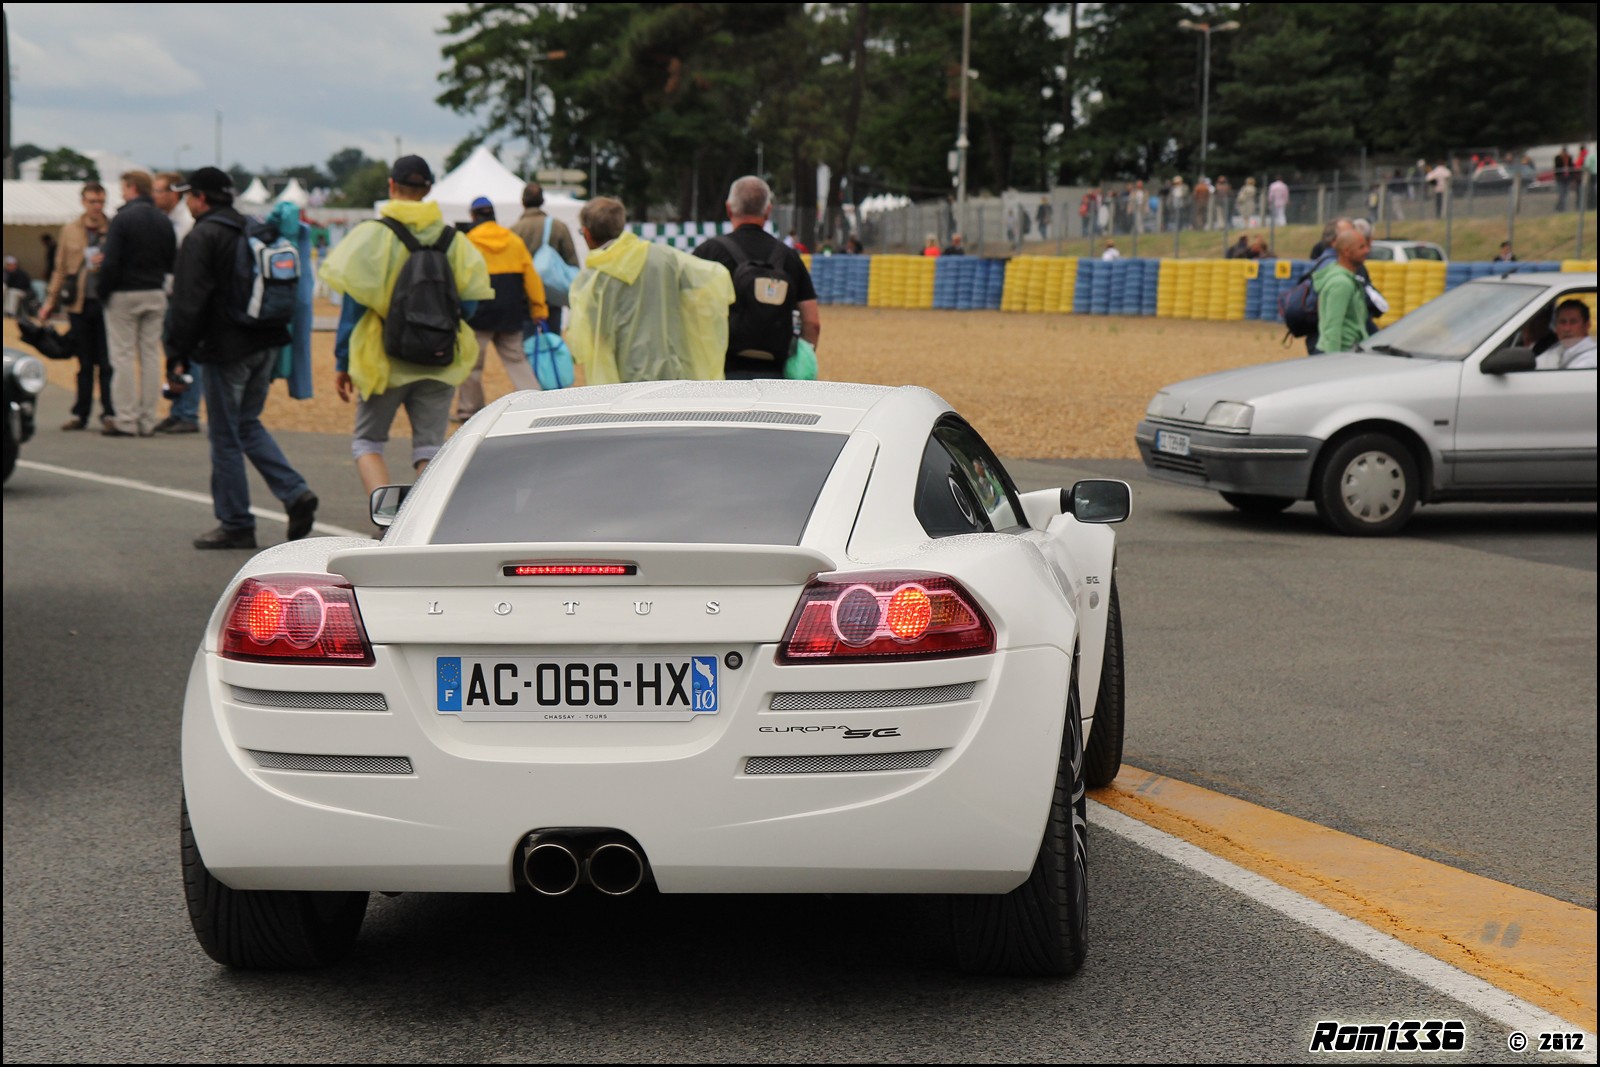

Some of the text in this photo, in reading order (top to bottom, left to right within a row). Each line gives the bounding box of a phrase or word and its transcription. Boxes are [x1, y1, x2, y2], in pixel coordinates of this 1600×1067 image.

[428, 601, 721, 615] LOTUS
[466, 663, 691, 706] AC-066-HX
[444, 689, 453, 702] F
[758, 725, 901, 739] EUROPA SE
